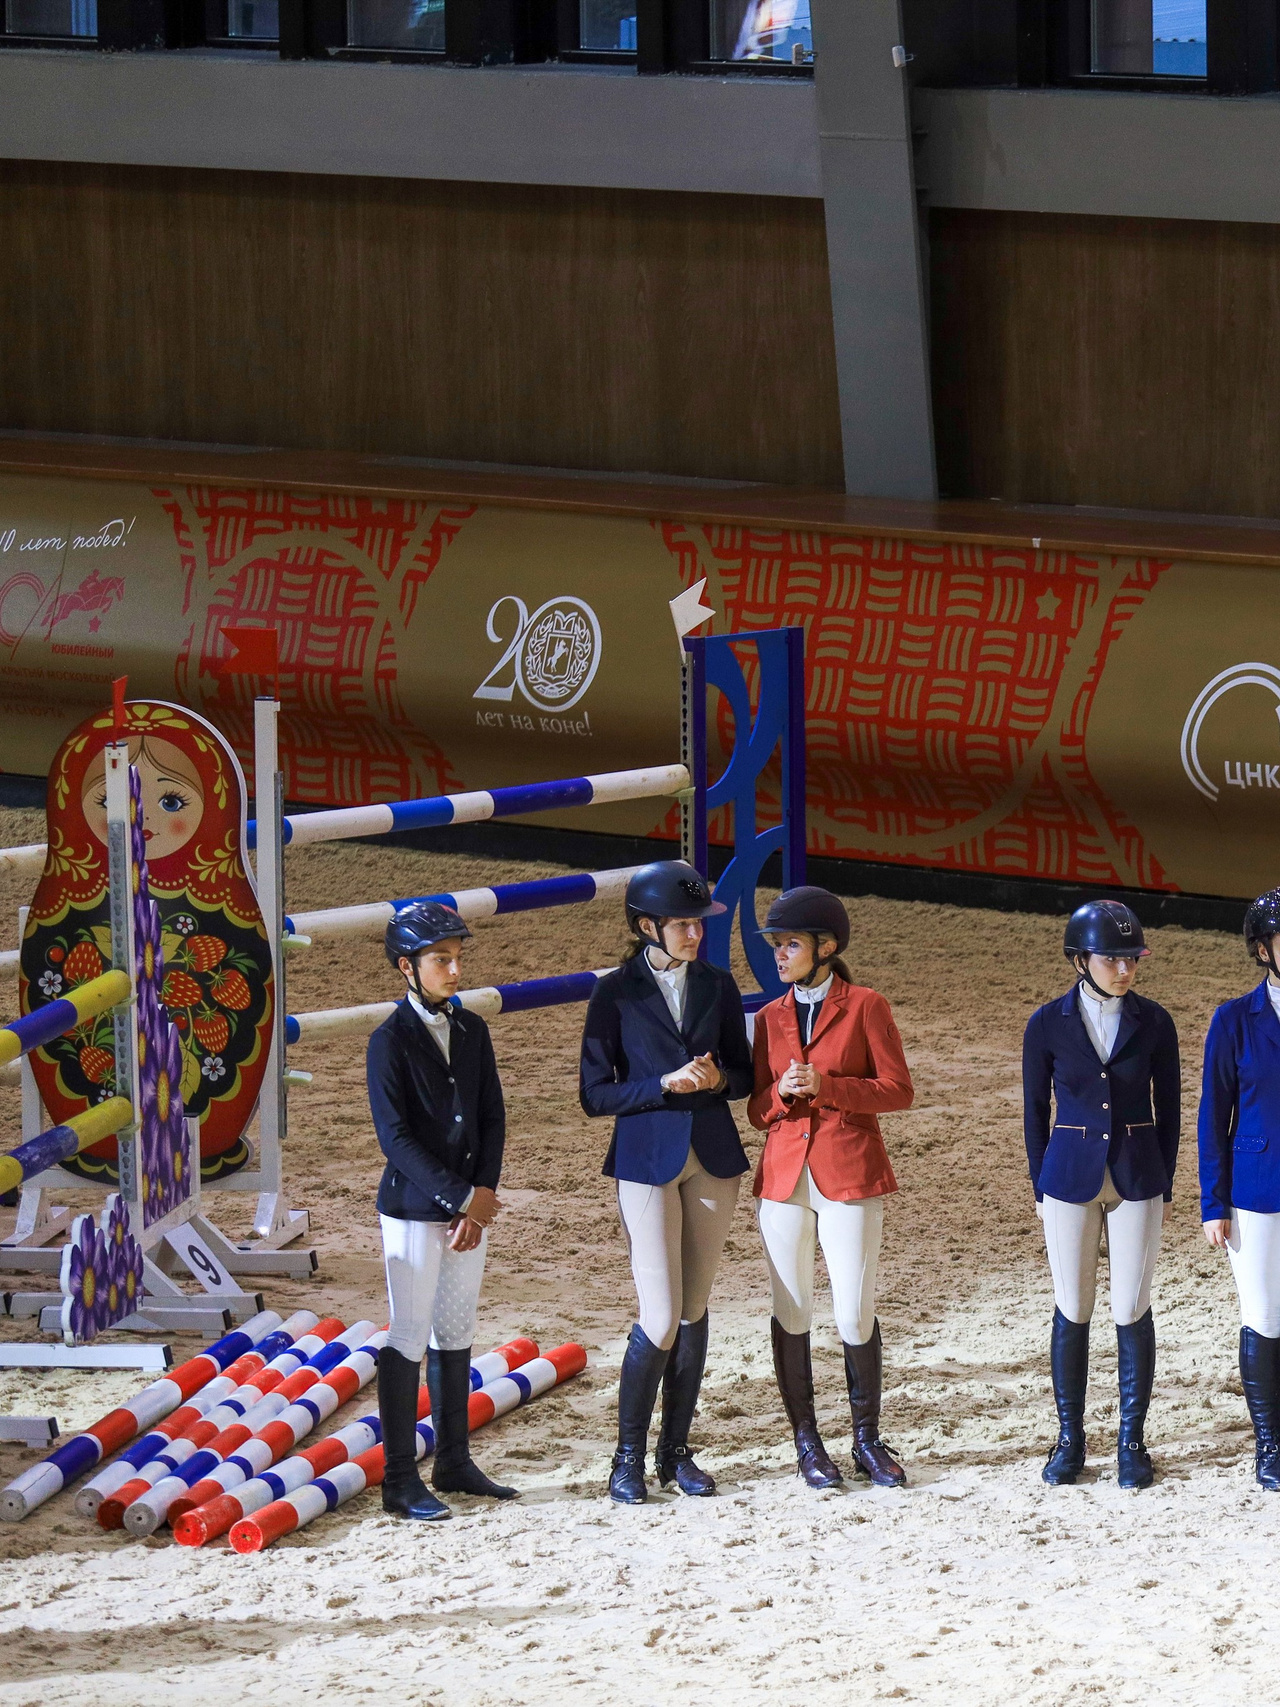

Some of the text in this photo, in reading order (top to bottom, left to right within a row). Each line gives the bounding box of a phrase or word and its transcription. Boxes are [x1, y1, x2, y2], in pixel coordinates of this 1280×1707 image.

[19, 537, 67, 551] лет
[73, 515, 137, 549] побед!
[51, 643, 115, 659] ЮБИЛЕЙНЫЙ
[473, 595, 603, 713] 20
[475, 711, 593, 736] лет на коне!
[188, 1244, 222, 1286] 9
